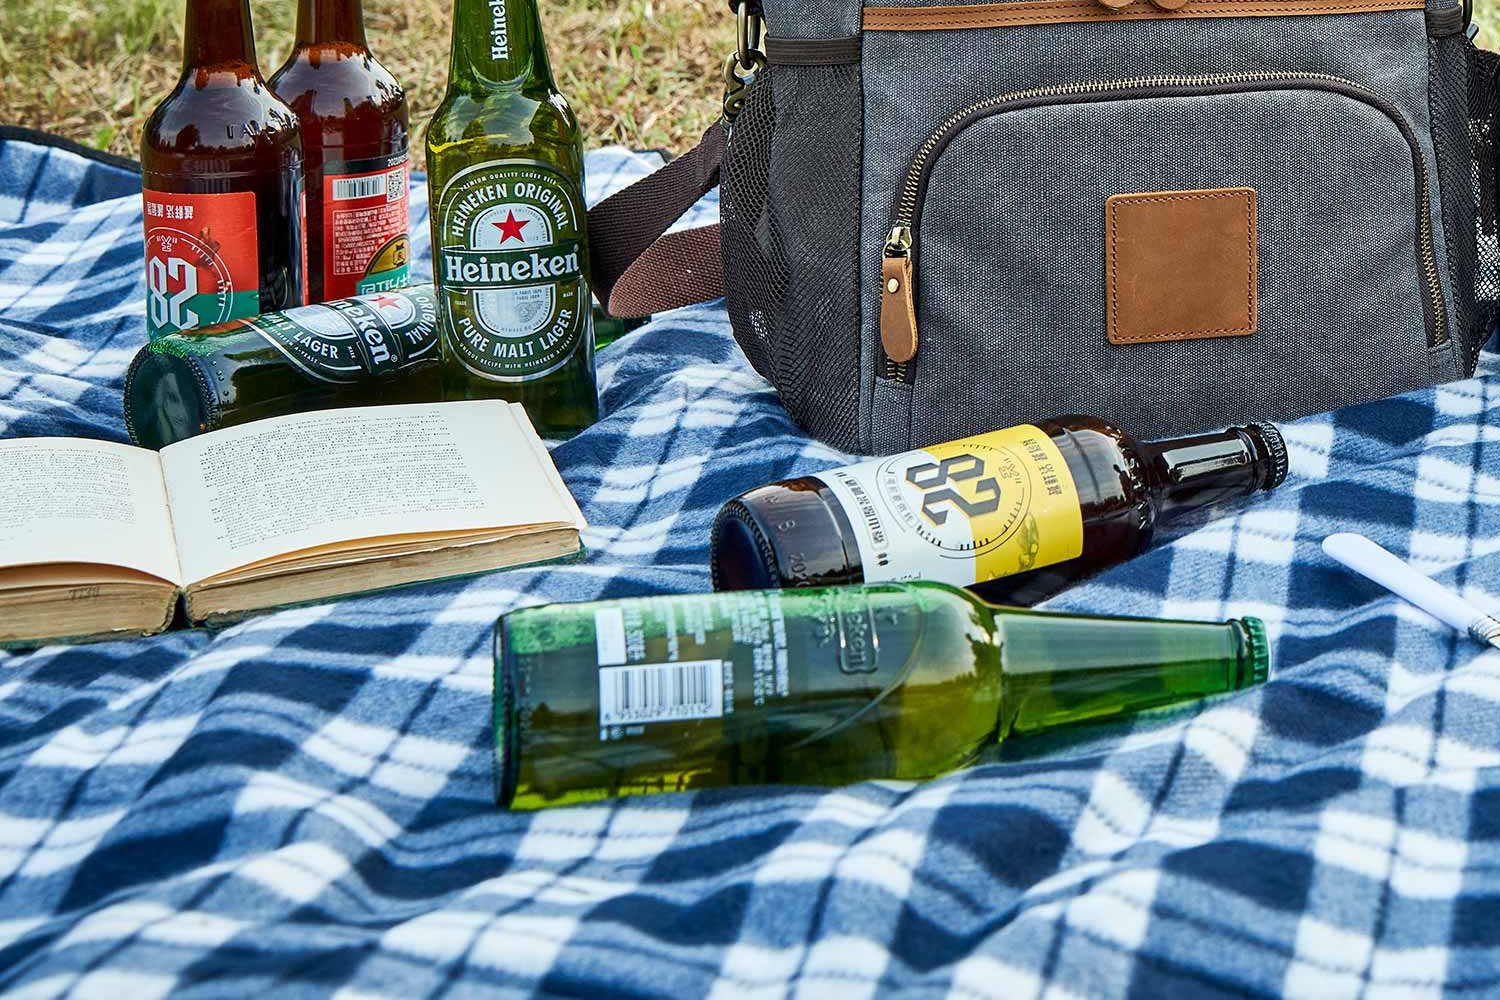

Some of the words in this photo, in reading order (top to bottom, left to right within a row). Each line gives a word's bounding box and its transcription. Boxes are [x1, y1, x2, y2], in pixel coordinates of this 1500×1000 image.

[452, 183, 508, 237] HEINEKEN
[514, 182, 569, 230] ORIGINAL
[445, 252, 579, 283] Heineken
[328, 301, 391, 365] neken
[405, 296, 436, 344] ORIGINAL
[458, 317, 490, 352] PURE
[493, 341, 534, 358] MALT
[539, 309, 573, 350] LAGER
[294, 331, 339, 360] LAGER
[905, 453, 1001, 526] 28
